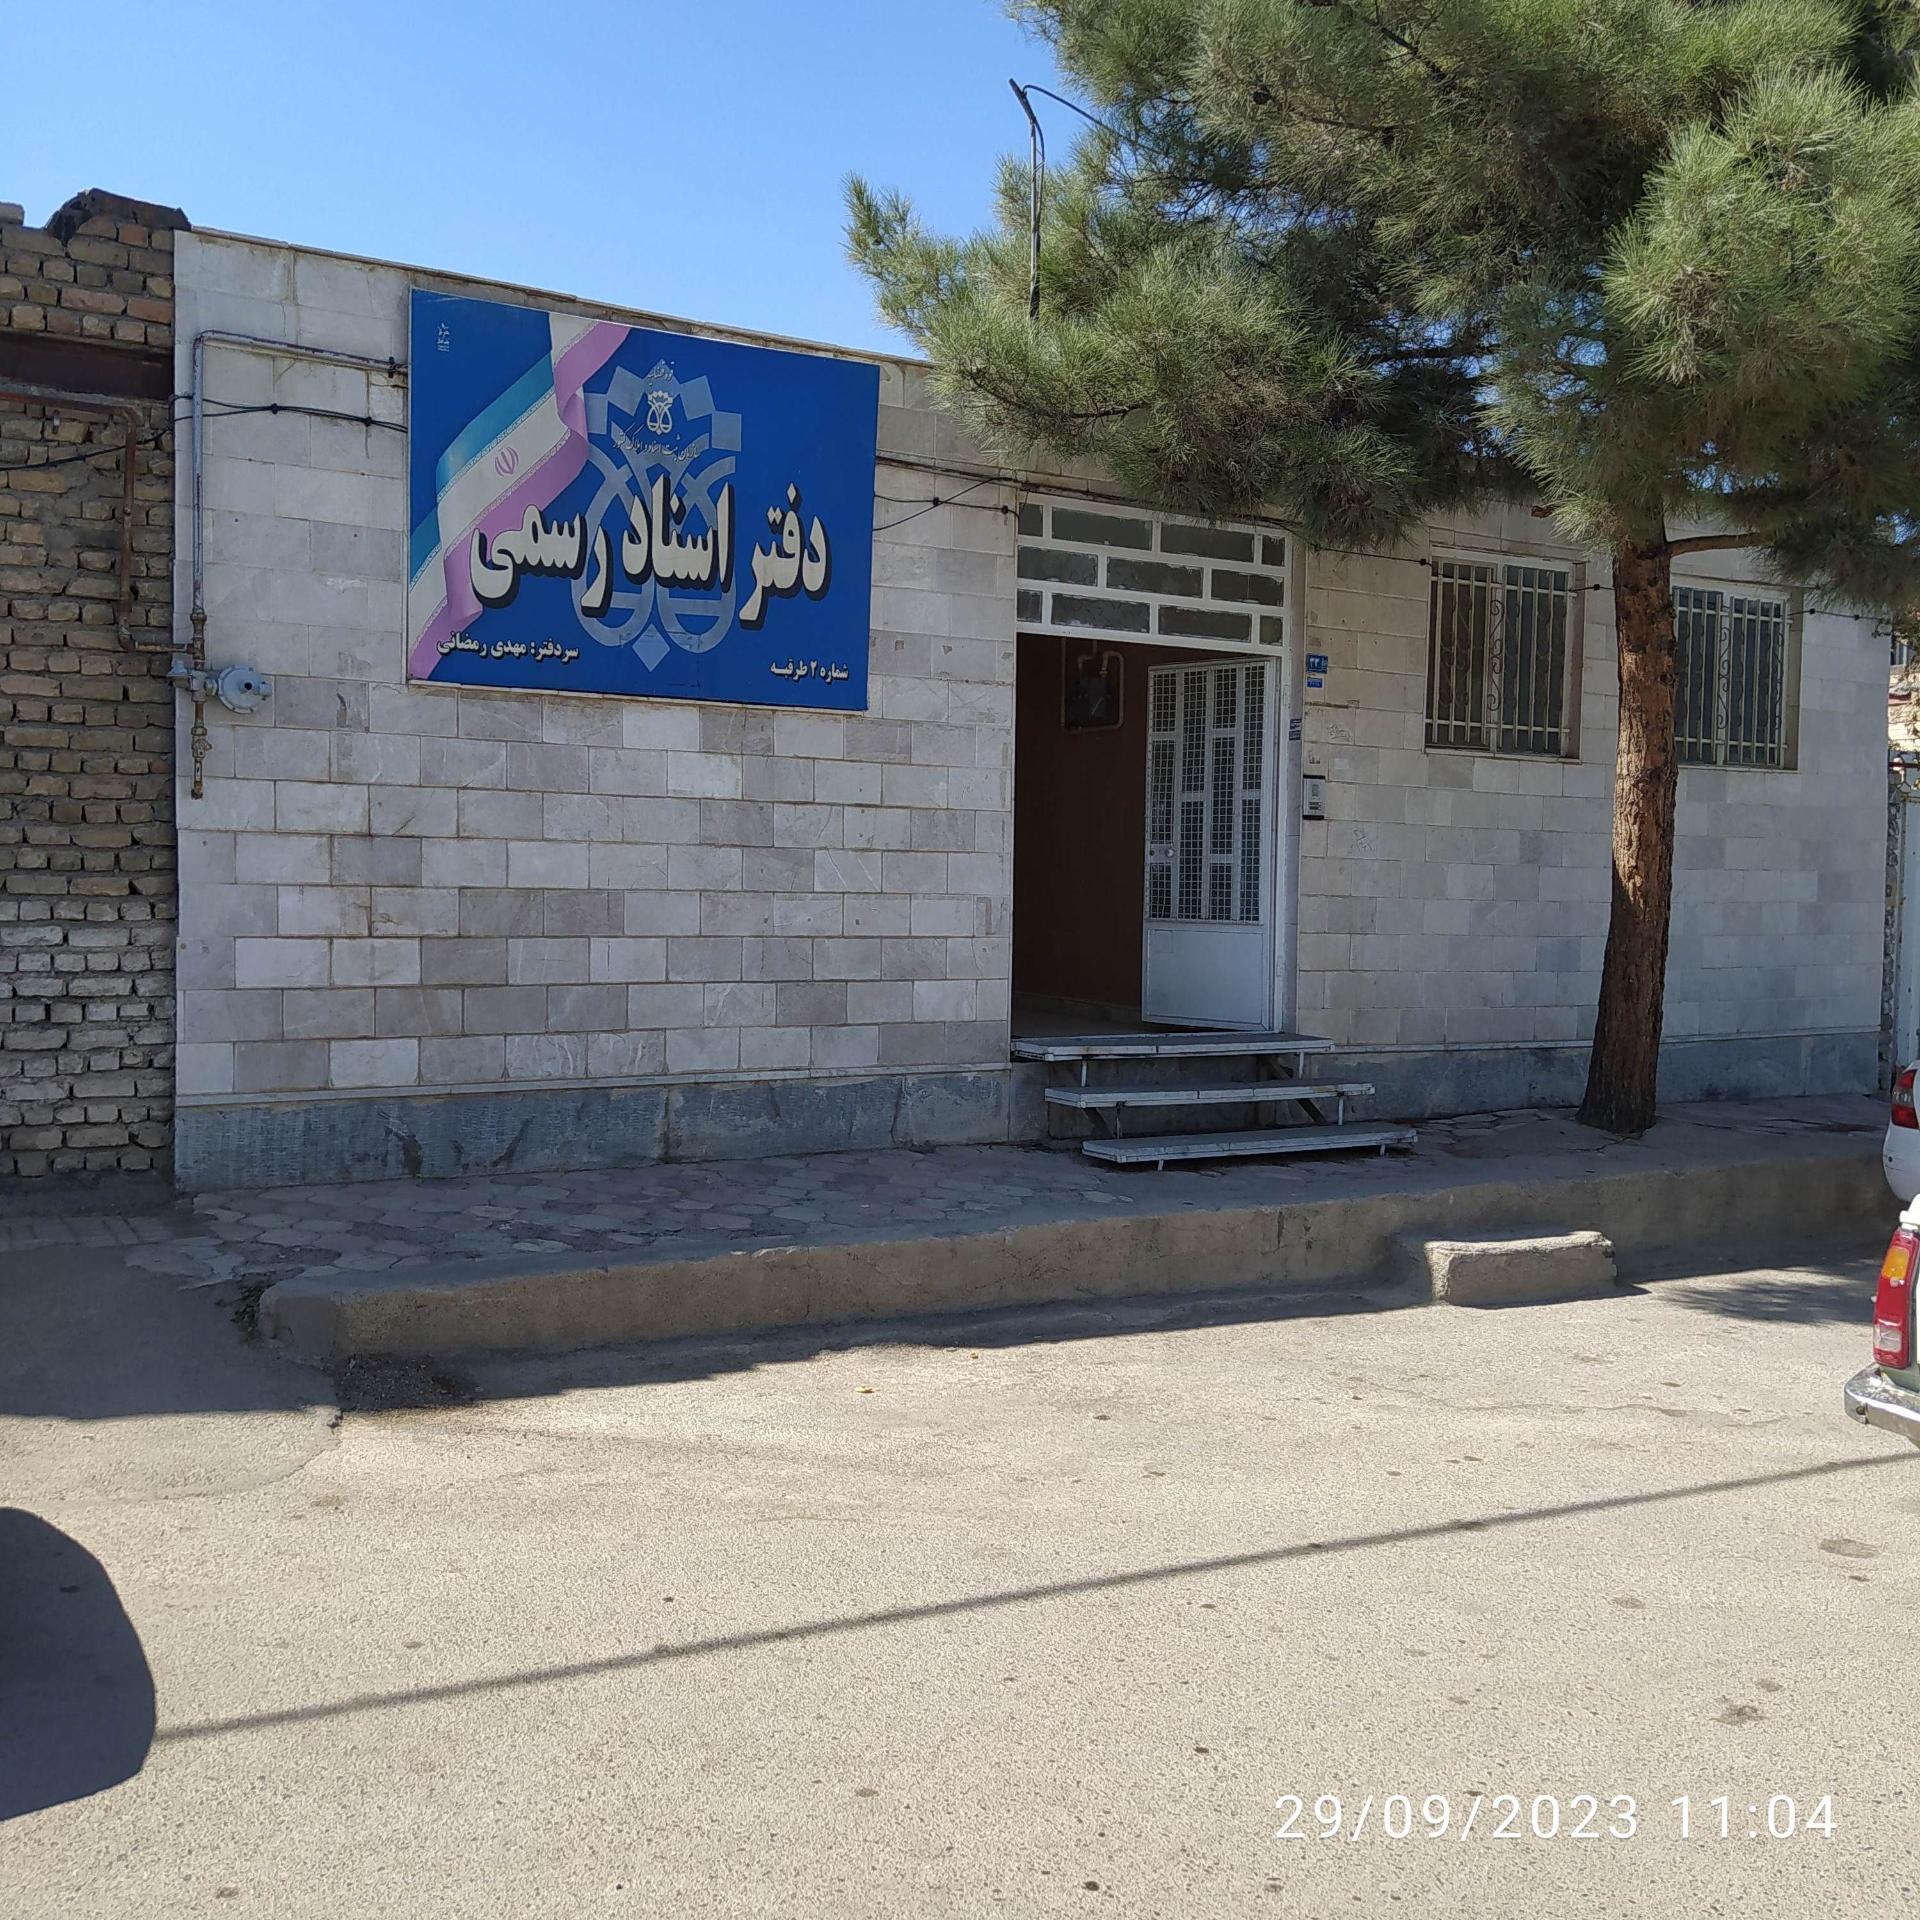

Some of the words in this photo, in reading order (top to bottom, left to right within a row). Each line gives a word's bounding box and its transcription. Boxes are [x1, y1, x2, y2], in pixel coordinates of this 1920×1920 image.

[622, 473, 733, 590] اسناد
[469, 503, 610, 614] رسمی
[738, 481, 830, 624] دفتر
[437, 631, 487, 657] رمضانی
[490, 640, 528, 658] مهدی
[770, 659, 808, 680] طرقبه
[810, 660, 817, 678] ۲
[820, 663, 849, 682] شماره
